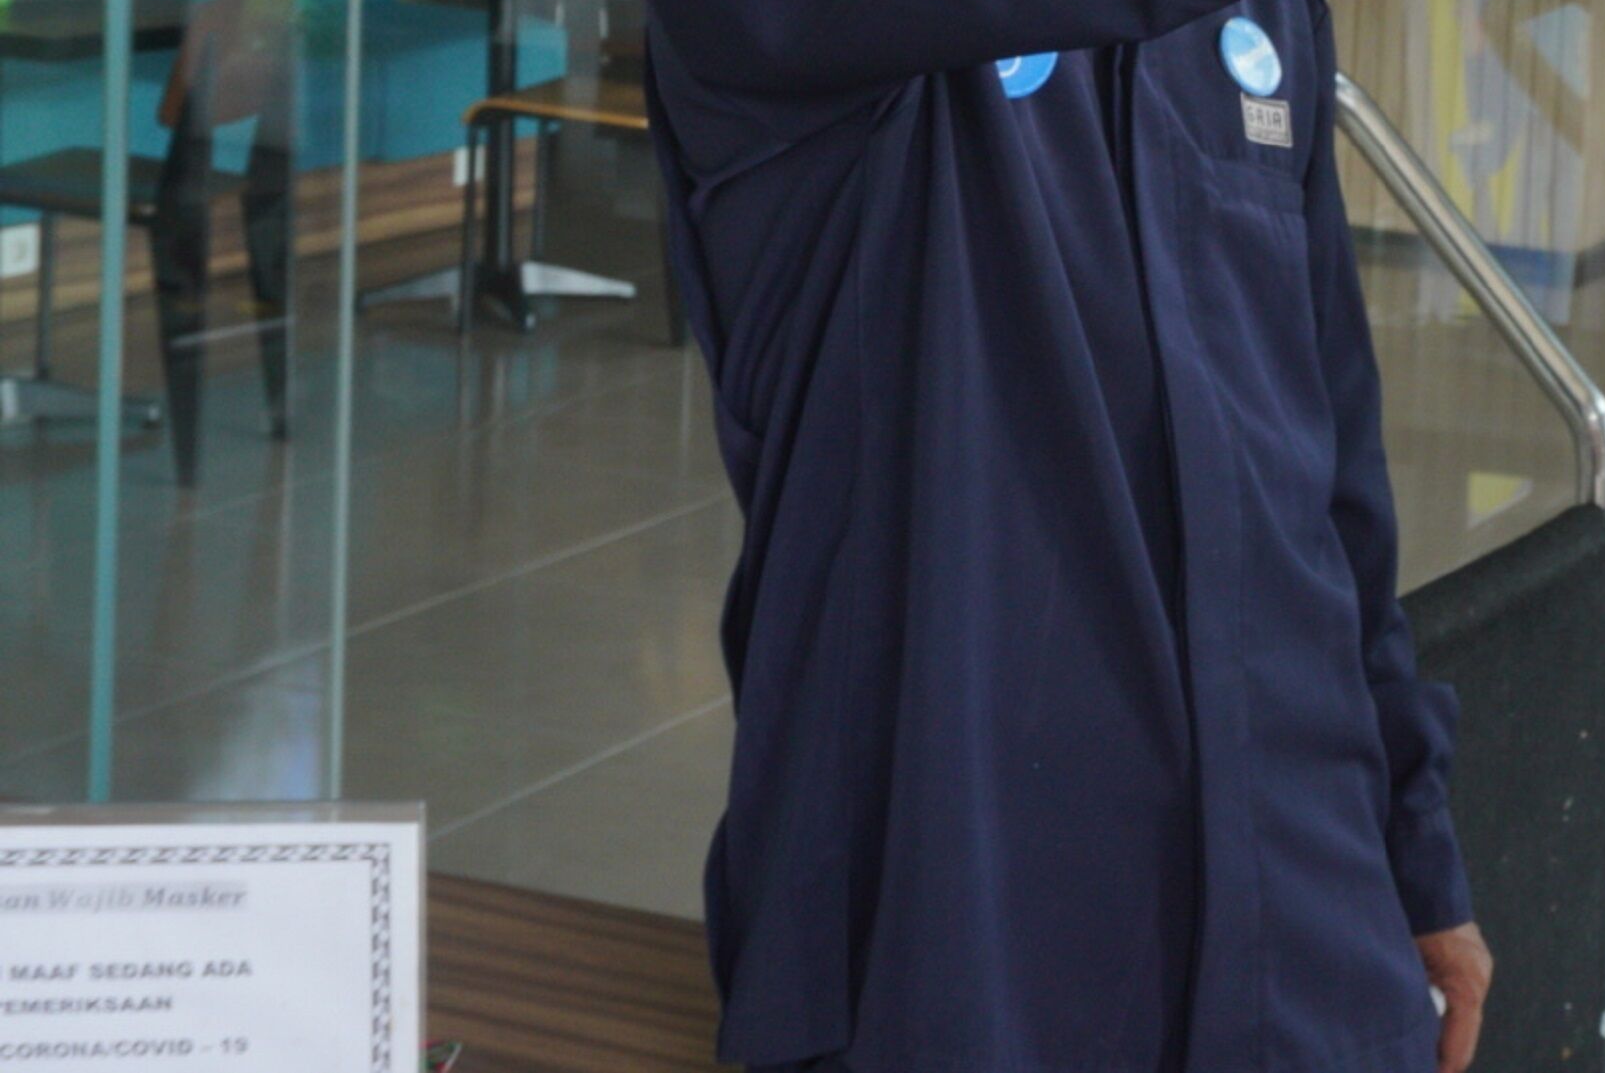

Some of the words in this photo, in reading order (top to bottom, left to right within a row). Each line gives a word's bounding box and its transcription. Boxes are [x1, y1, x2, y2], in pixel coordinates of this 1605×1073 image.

[49, 887, 135, 914] Wajib
[141, 885, 247, 910] Masker
[9, 962, 78, 980] MAAF
[89, 960, 195, 980] SEDANG
[201, 958, 253, 979] ADA
[219, 1034, 249, 1056] 19
